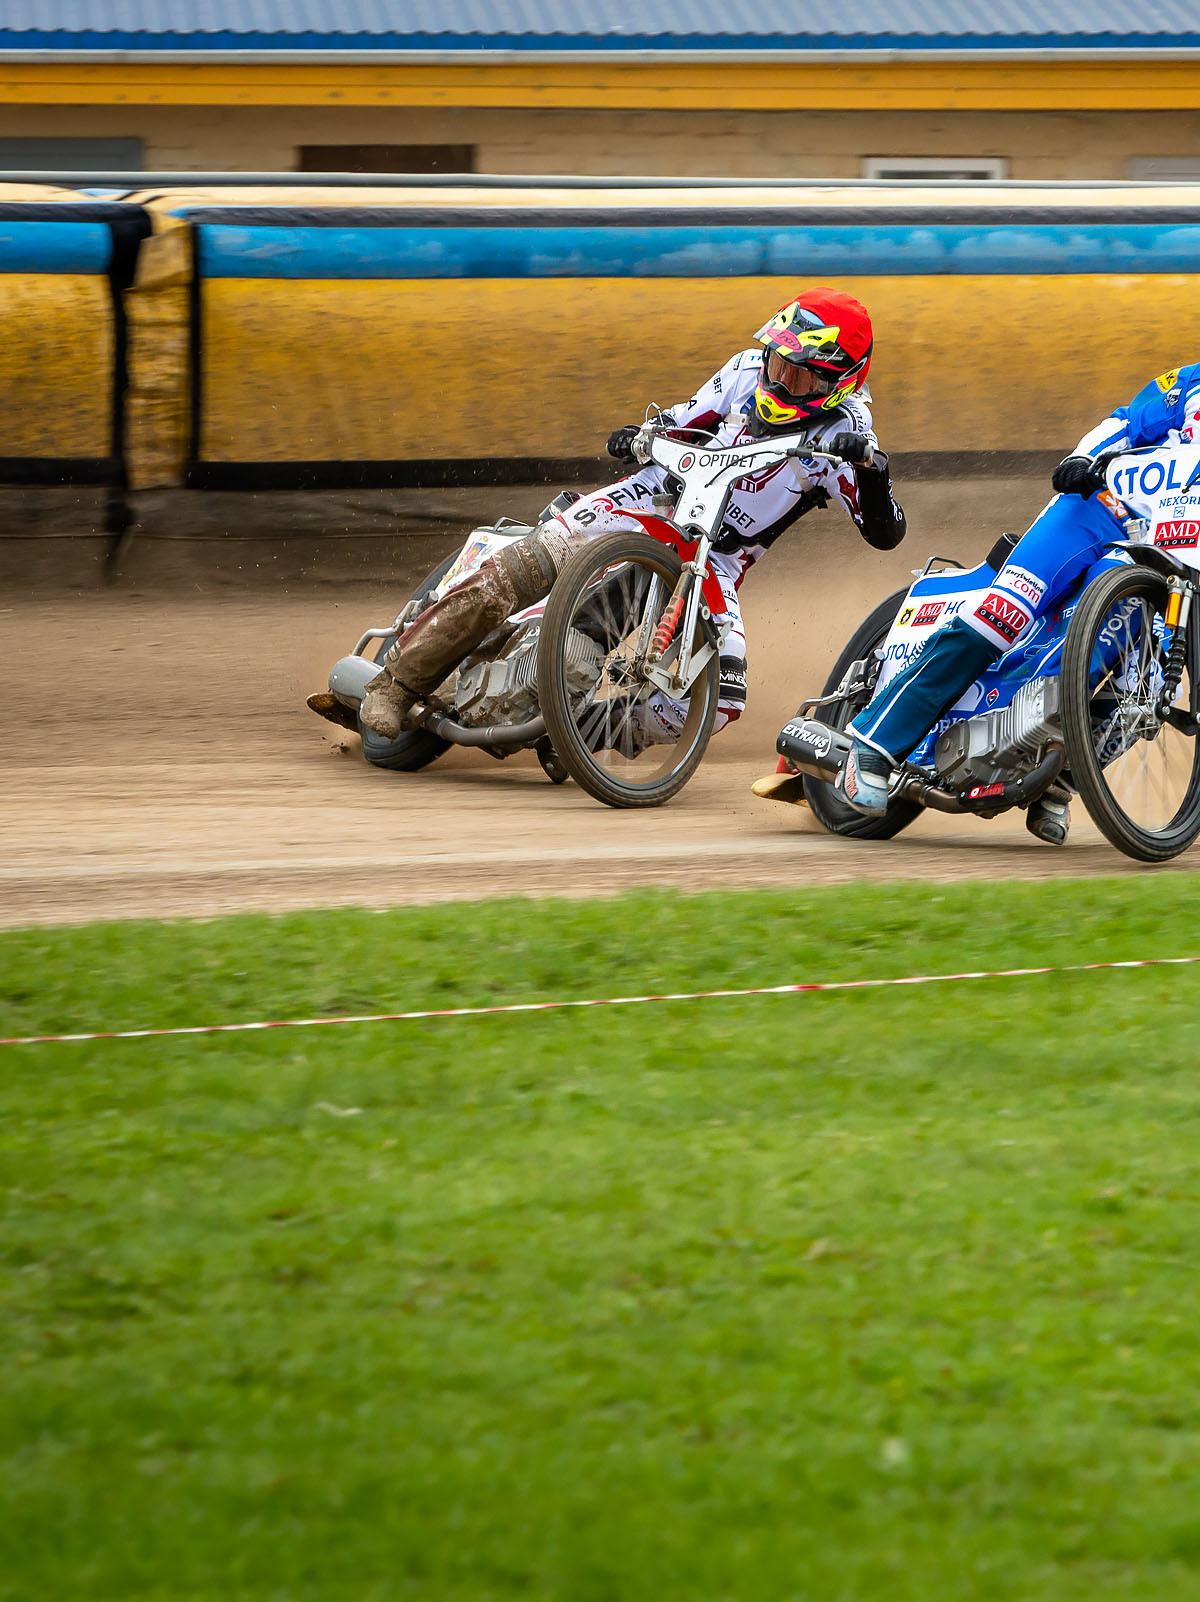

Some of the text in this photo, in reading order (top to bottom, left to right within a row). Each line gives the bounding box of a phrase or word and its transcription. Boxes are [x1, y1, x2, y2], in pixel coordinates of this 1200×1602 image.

[699, 453, 757, 469] OPTIBET
[1156, 521, 1199, 540] AMD
[1156, 538, 1195, 547] GROUP
[1009, 580, 1040, 604] .com
[917, 603, 944, 617] AMD
[983, 596, 1026, 631] AMD
[980, 608, 1016, 638] GROUP
[782, 724, 829, 748] EXTRANS
